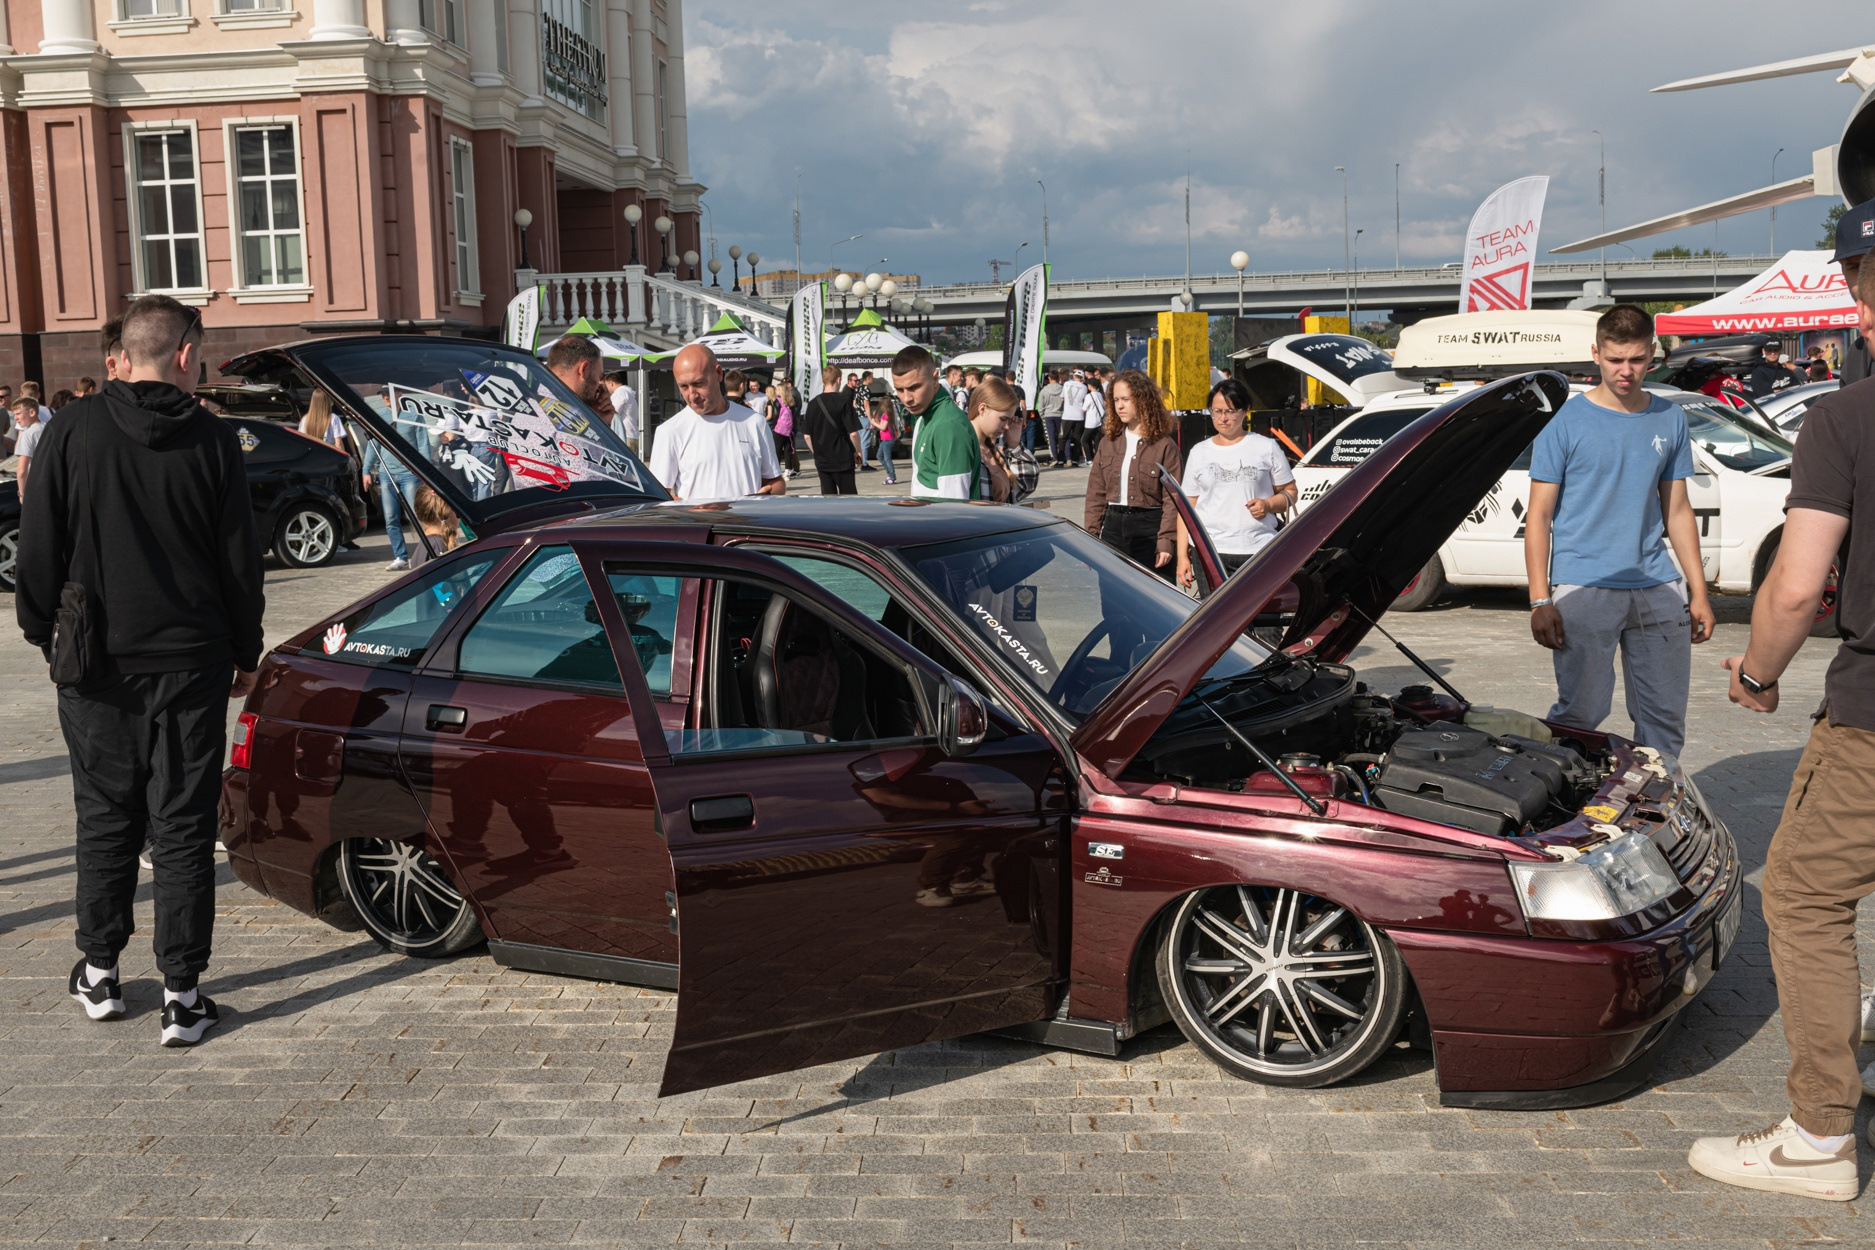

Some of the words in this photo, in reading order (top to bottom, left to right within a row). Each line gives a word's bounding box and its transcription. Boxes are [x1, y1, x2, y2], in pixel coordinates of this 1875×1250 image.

[1476, 220, 1534, 249] TEAM
[1471, 241, 1527, 270] AURA
[1747, 269, 1848, 297] AUR
[1739, 297, 1763, 305] CAR
[1815, 292, 1850, 300] ACCE
[1711, 313, 1860, 330] www.aurae
[1437, 334, 1468, 344] TEAM
[1471, 331, 1520, 344] SWAT
[1521, 333, 1562, 343] RUSSIA
[478, 380, 519, 407] 12
[548, 403, 586, 433] 112
[486, 436, 571, 467] AUTOCLUB
[344, 642, 411, 658] AVTOKASTA.RU
[968, 603, 1048, 675] AVTOKASTA.RU
